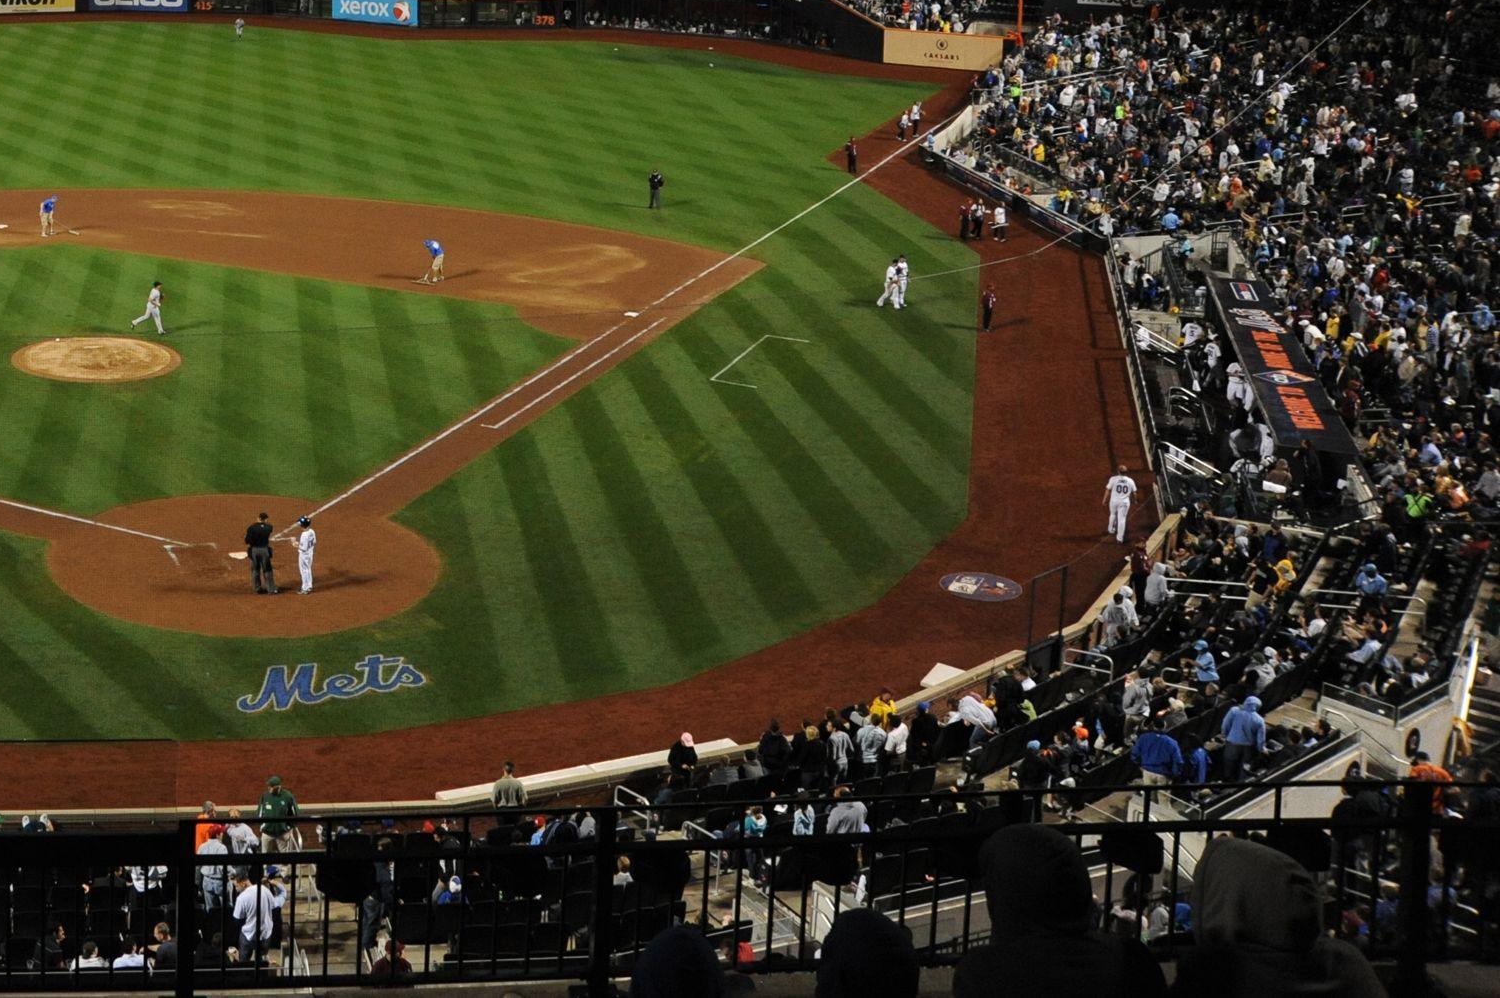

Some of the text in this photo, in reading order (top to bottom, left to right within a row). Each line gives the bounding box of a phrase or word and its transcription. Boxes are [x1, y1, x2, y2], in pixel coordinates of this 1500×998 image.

[534, 15, 555, 25] 378
[924, 52, 960, 60] CAESARS
[1116, 485, 1128, 494] 00
[236, 654, 426, 713] Mets
